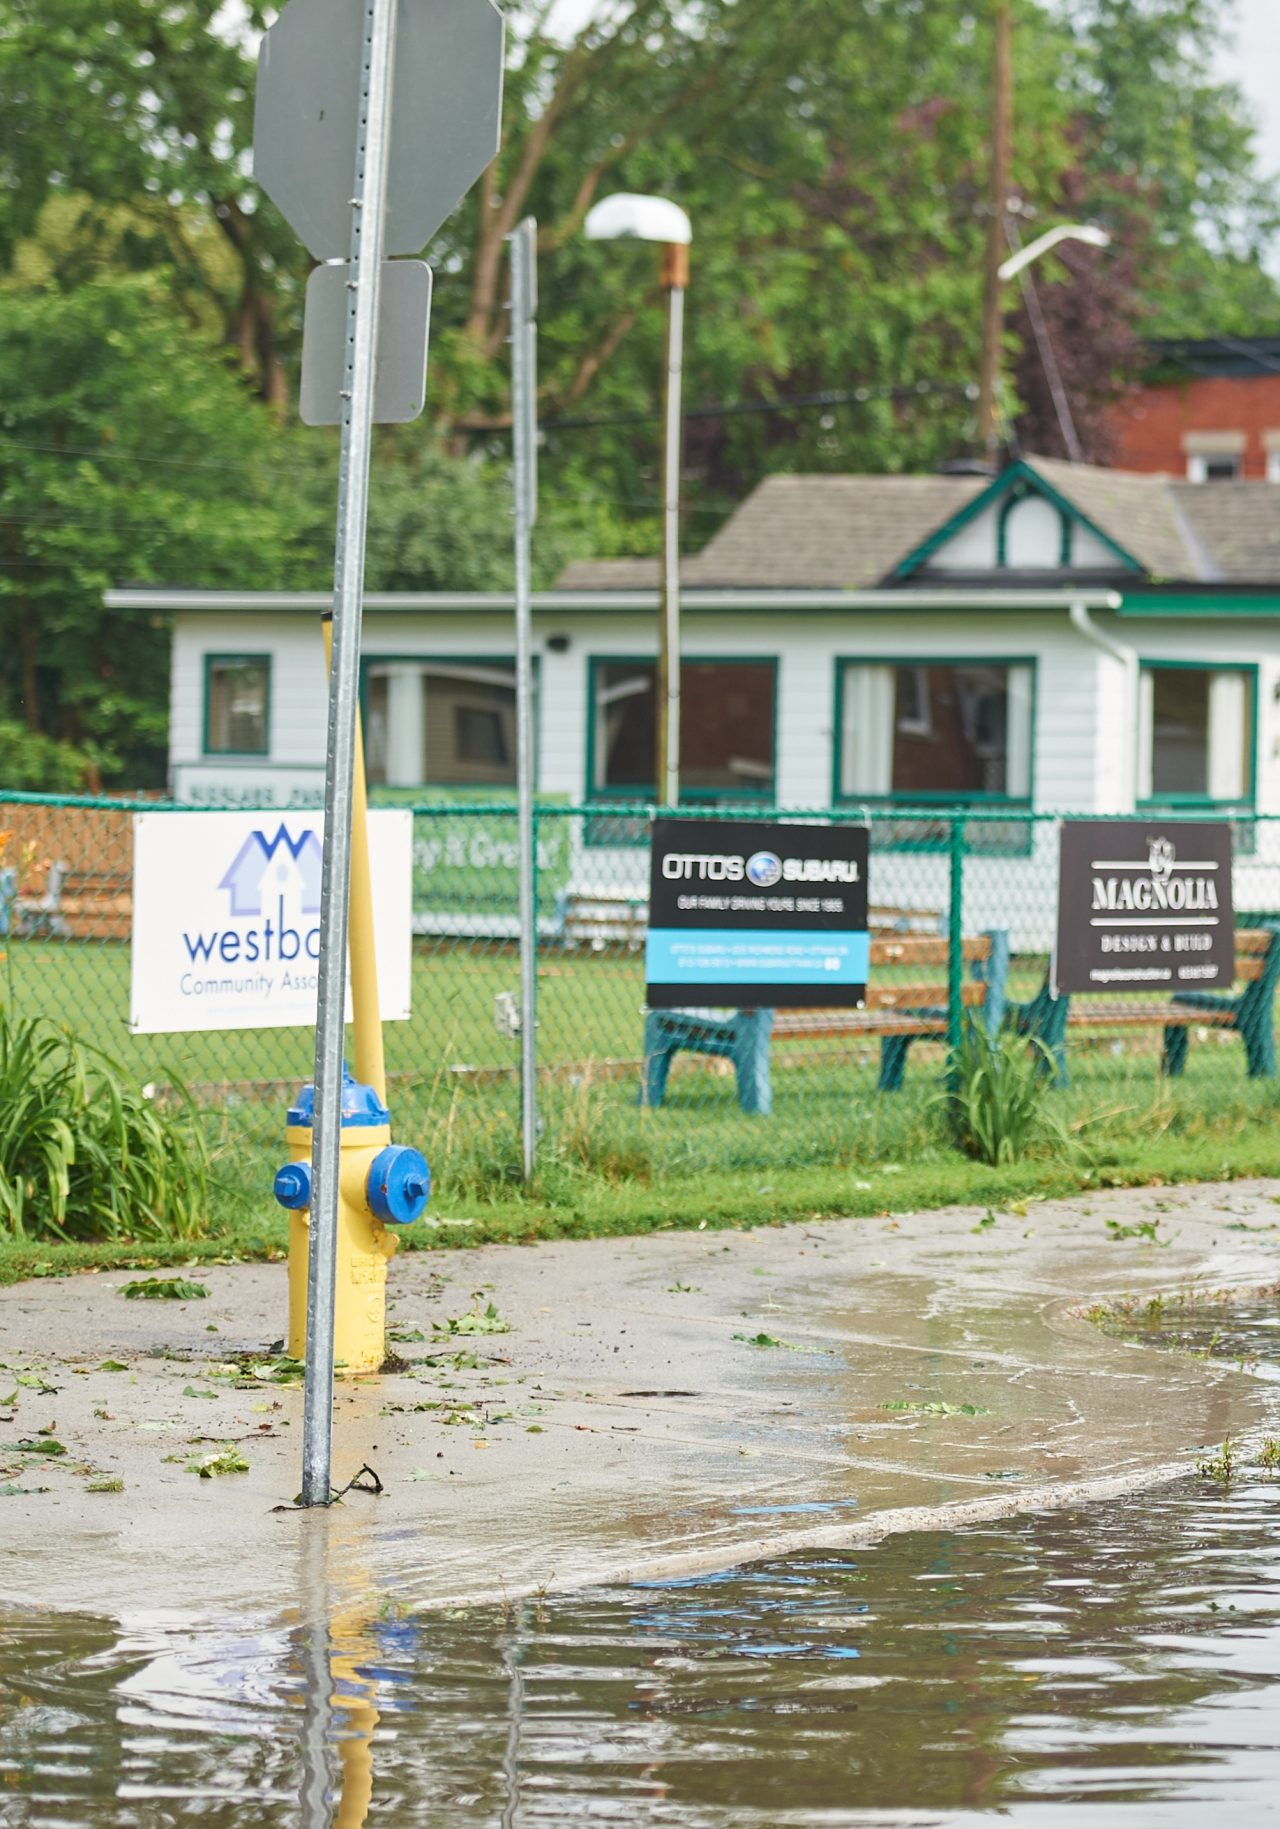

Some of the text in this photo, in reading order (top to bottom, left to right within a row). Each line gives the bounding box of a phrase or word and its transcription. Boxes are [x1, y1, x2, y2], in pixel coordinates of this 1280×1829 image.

[782, 858, 859, 882] SUBARU
[1091, 877, 1219, 910] MAGNOLIA
[182, 894, 320, 963] westbo
[1101, 933, 1213, 952] DESIGN & BUILD
[180, 971, 274, 997] Community
